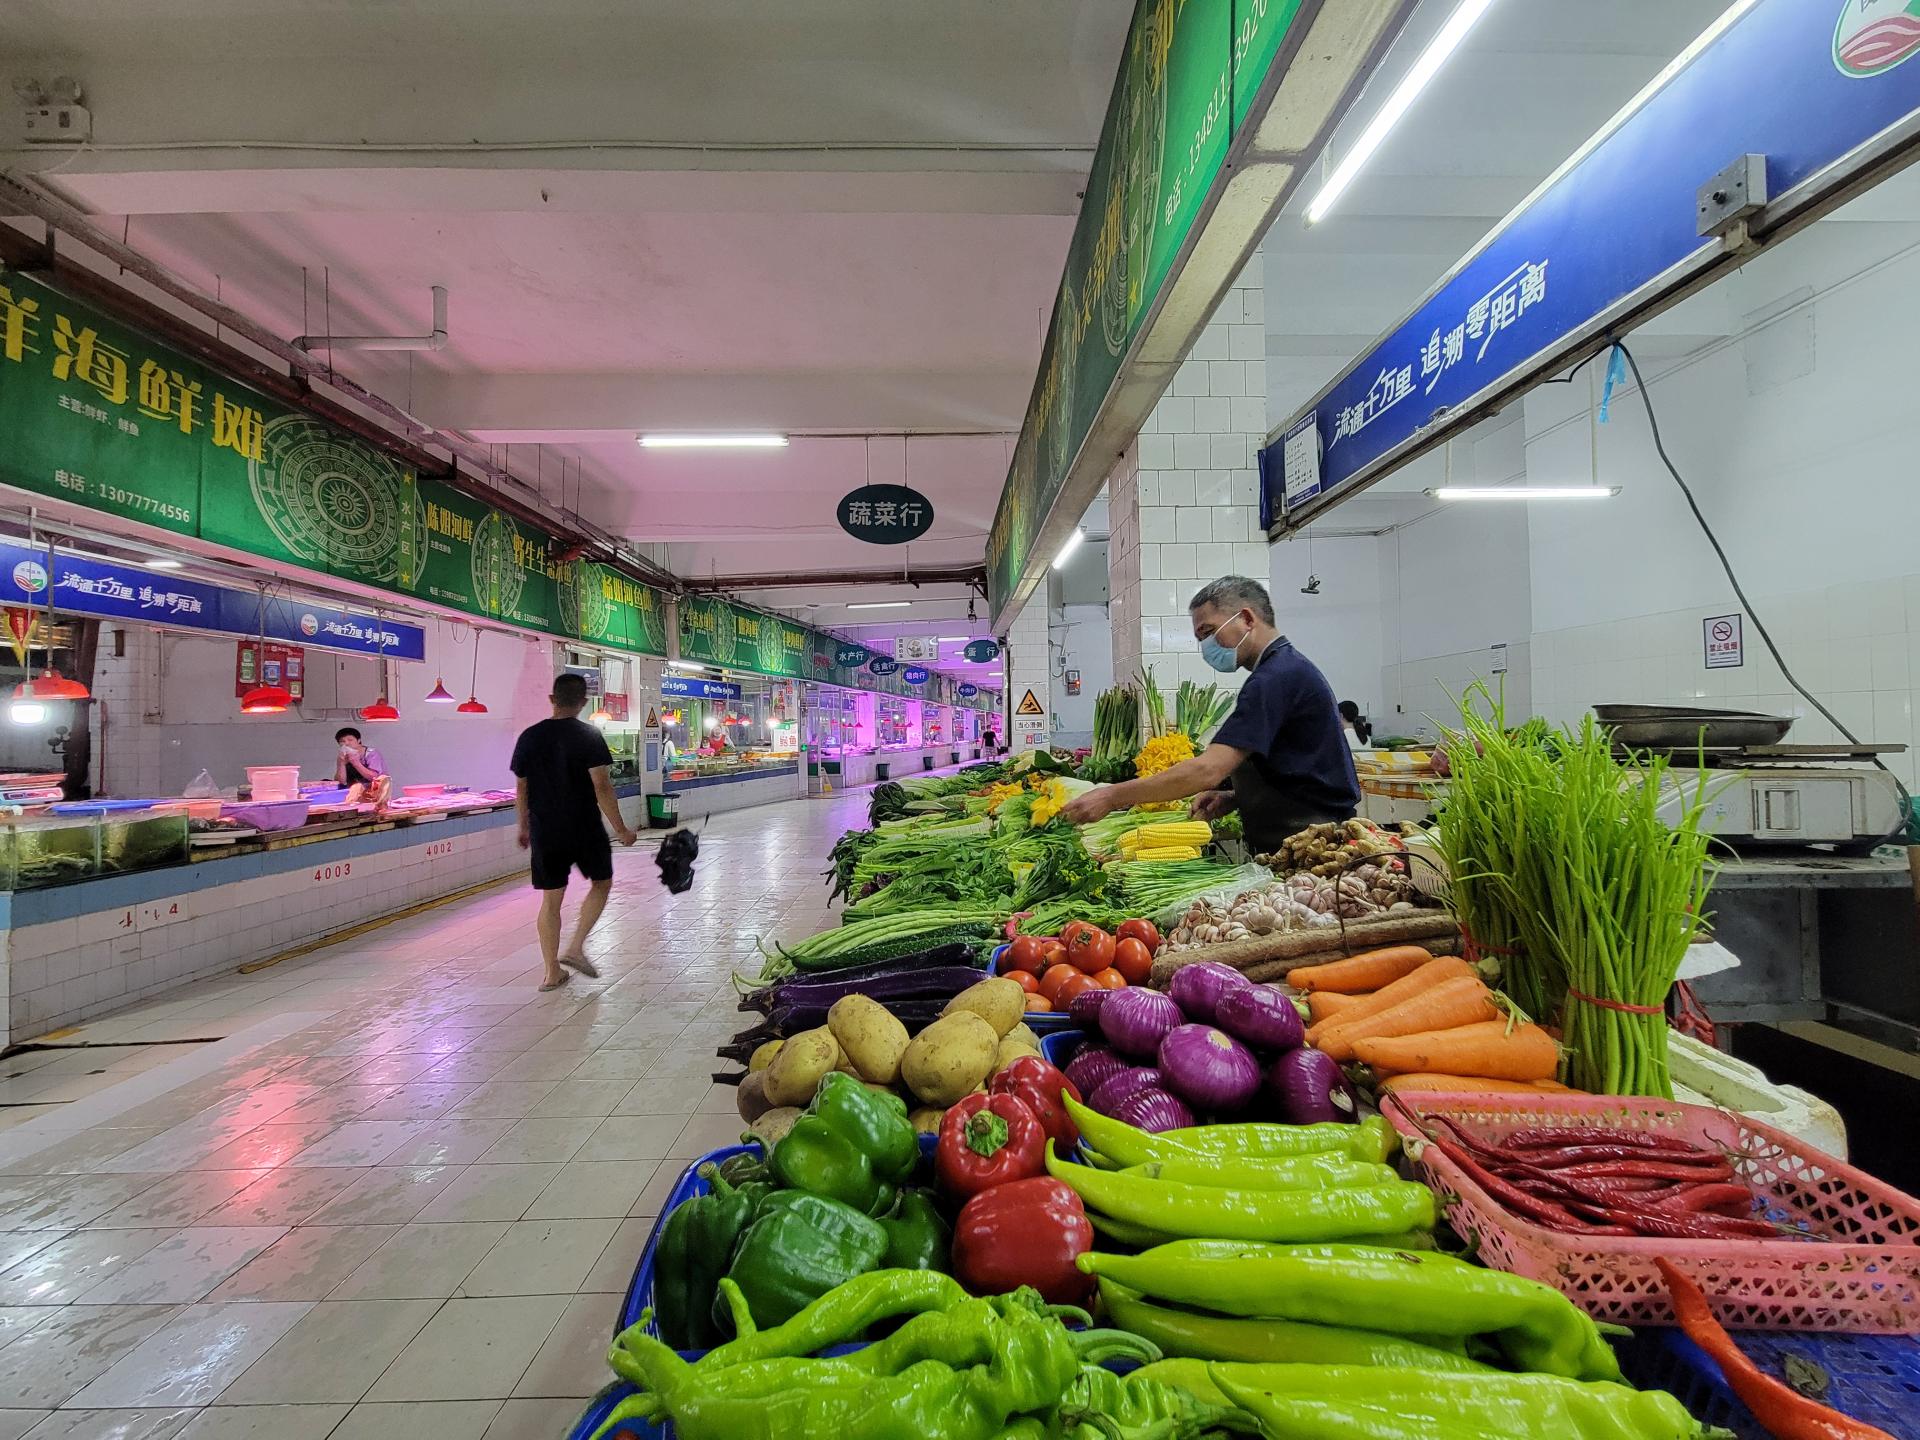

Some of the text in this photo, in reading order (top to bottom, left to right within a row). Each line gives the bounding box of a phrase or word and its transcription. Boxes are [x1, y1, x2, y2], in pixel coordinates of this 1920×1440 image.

[1328, 258, 1549, 452] 流通千万里 追溯零距离
[848, 501, 923, 527] 蔬菜行
[400, 501, 412, 556] 水产区
[53, 571, 203, 615] 流通千万里 追溯零距离
[838, 651, 864, 661] 水产行
[1710, 641, 1738, 652] 禁止吸烟
[905, 671, 926, 680] 猪肉行
[426, 841, 453, 857] 4002
[314, 863, 352, 882] 4003
